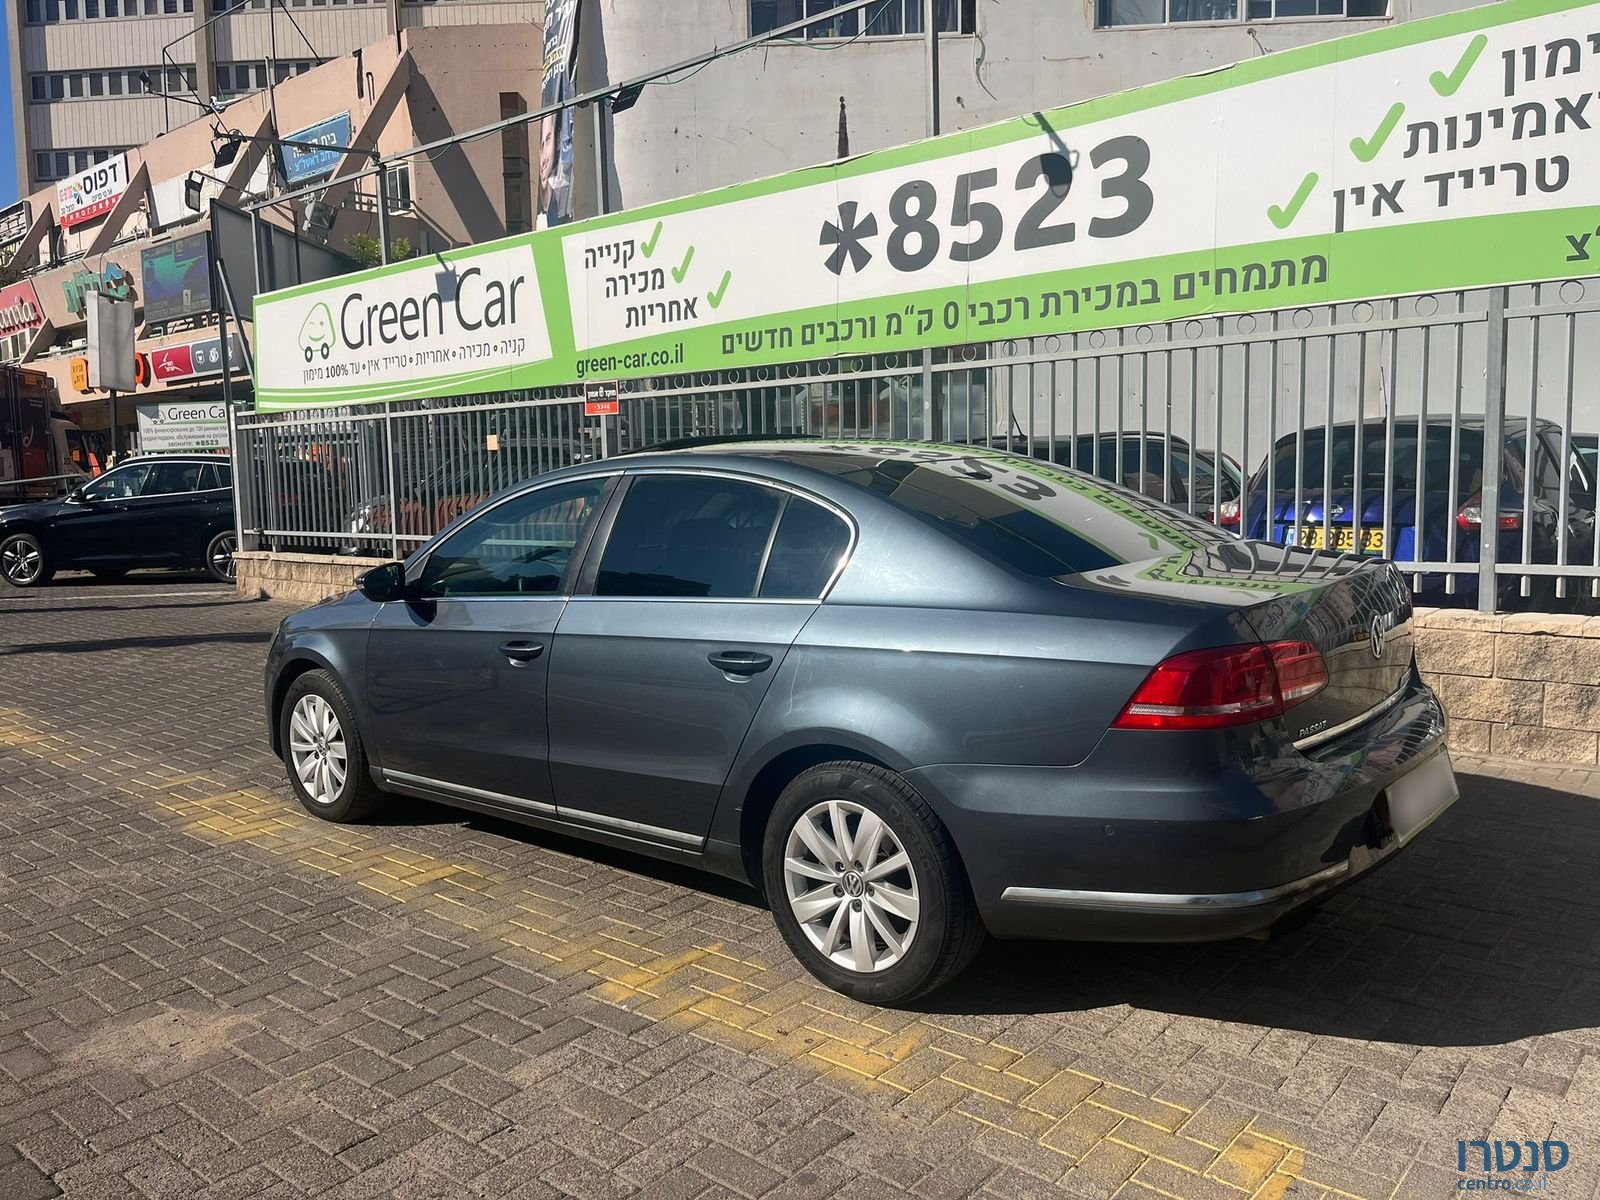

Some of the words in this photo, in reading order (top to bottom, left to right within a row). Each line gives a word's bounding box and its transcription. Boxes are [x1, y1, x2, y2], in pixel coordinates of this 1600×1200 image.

[1404, 90, 1600, 158] אמינות
[83, 163, 117, 195] דפוס
[1425, 156, 1569, 207] טרייד
[1334, 179, 1405, 233] אין
[585, 239, 635, 269] קנייה
[606, 267, 665, 297] מכירה
[1174, 255, 1327, 300] מתמחים
[341, 292, 444, 349] Green
[455, 267, 525, 331] Car
[969, 296, 1029, 325] רכבי
[1040, 278, 1161, 317] במכירת
[626, 297, 698, 328] אחריות
[722, 328, 793, 354] חדשים
[801, 317, 876, 345] ורכבים
[415, 348, 449, 366] אחריות
[459, 341, 491, 361] מכירה
[500, 337, 525, 357] קניה
[577, 343, 684, 378] green-car.co.il
[303, 367, 323, 384] מימון
[325, 364, 349, 378] 100%
[367, 358, 380, 376] אין
[382, 354, 407, 370] טרייד
[168, 407, 206, 421] Green
[209, 405, 226, 419] Ca
[1298, 719, 1327, 738] PASSAT
